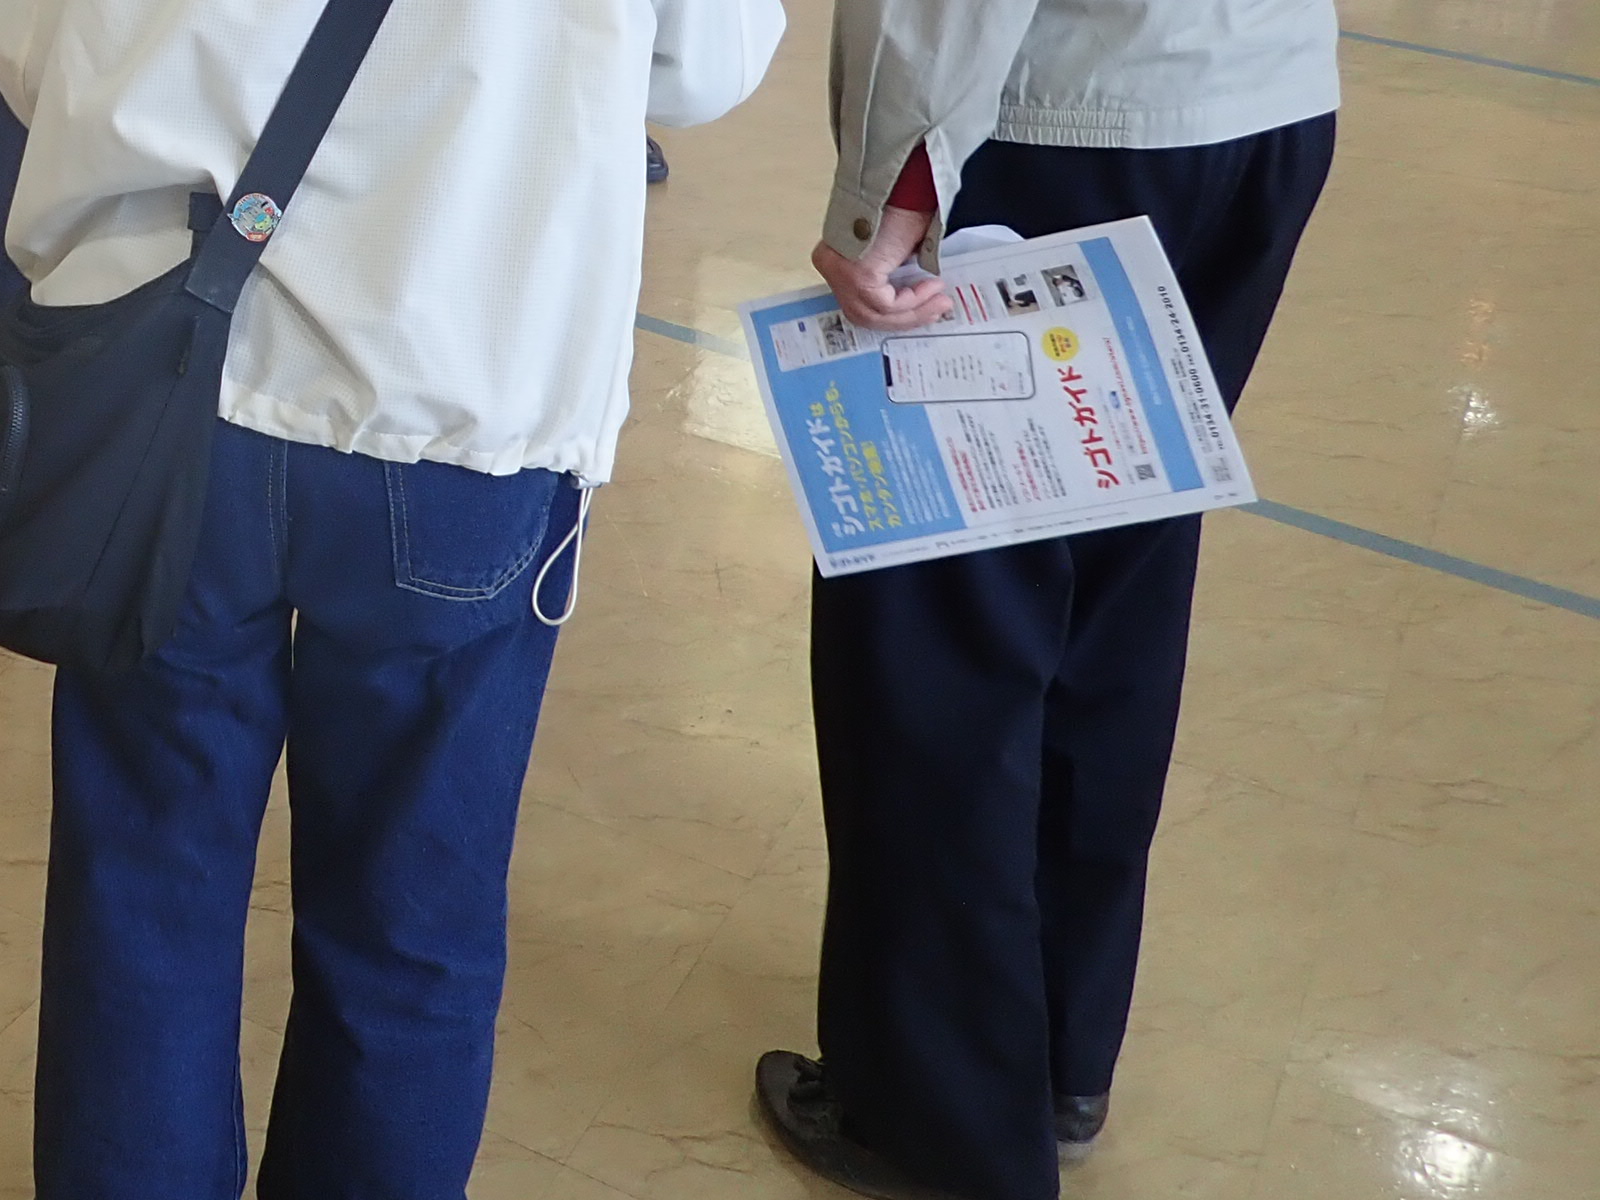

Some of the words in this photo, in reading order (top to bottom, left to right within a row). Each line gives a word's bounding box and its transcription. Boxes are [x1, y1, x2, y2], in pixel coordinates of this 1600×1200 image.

[1056, 364, 1120, 490] シゴトガイド
